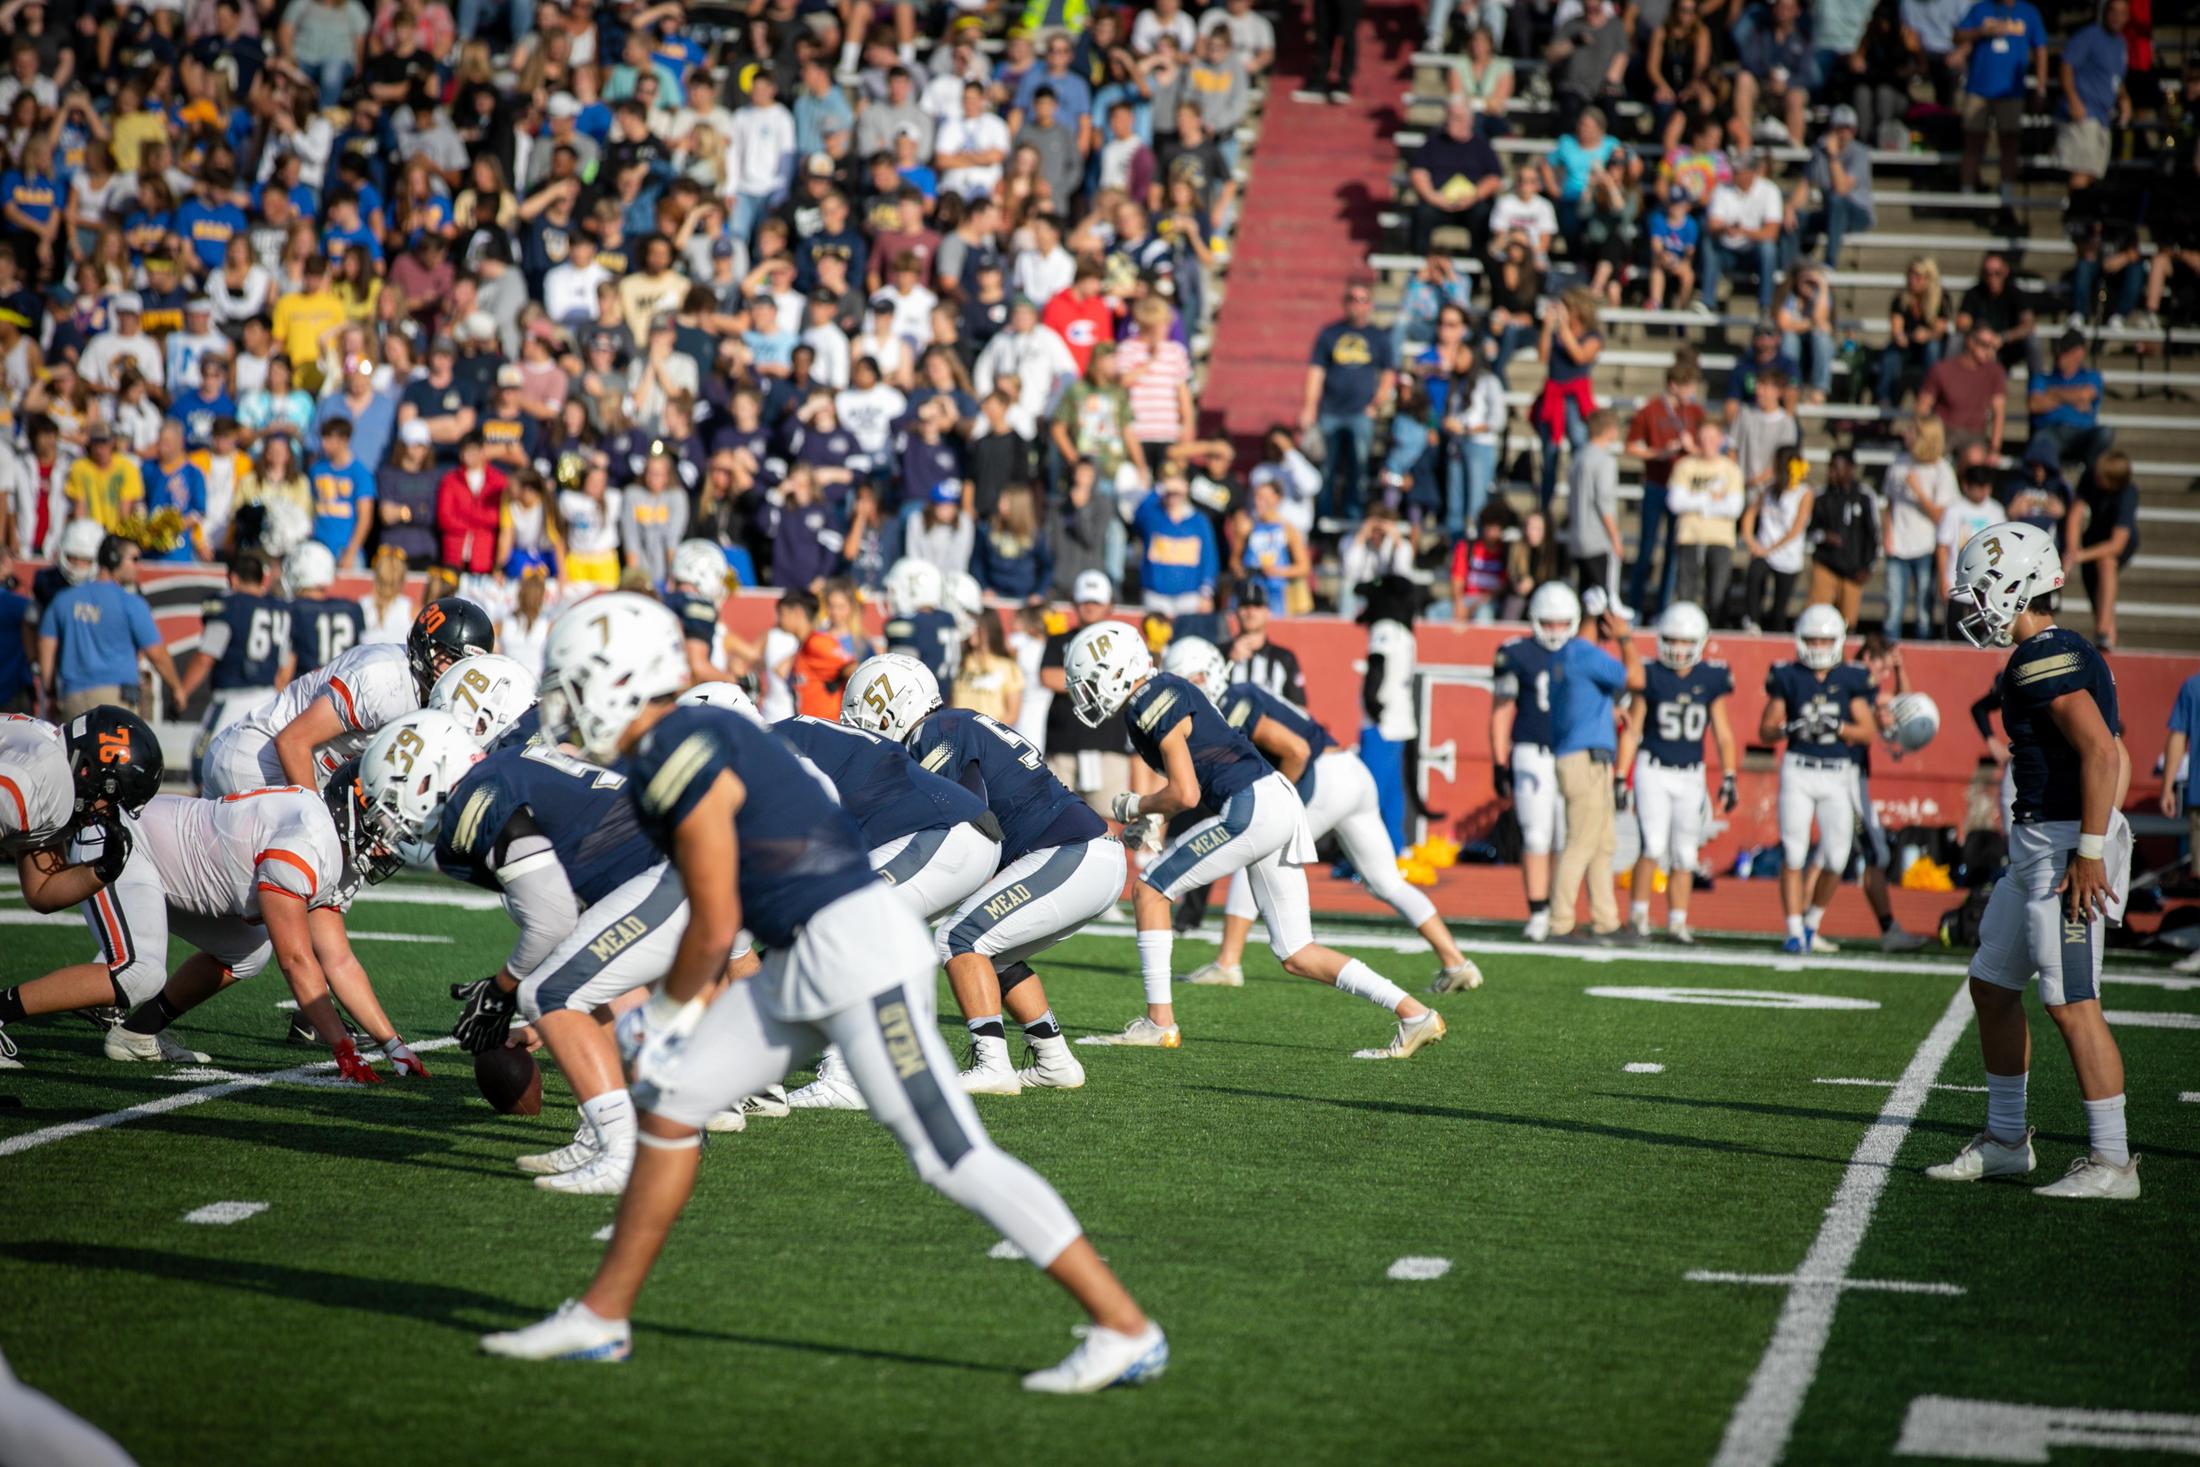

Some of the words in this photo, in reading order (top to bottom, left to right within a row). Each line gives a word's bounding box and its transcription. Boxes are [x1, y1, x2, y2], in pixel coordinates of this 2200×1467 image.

[1982, 536, 2004, 567] 3
[247, 607, 291, 663] 64
[317, 612, 355, 668] 12
[451, 668, 490, 713] 78
[863, 672, 895, 715] 57
[1657, 701, 1708, 742] 50
[98, 727, 131, 765] 76
[384, 728, 425, 775] 59
[1188, 825, 1232, 858] MEAD
[983, 883, 1032, 921] MEAD
[588, 915, 648, 962] MEAD
[878, 1001, 928, 1079] MEAD
